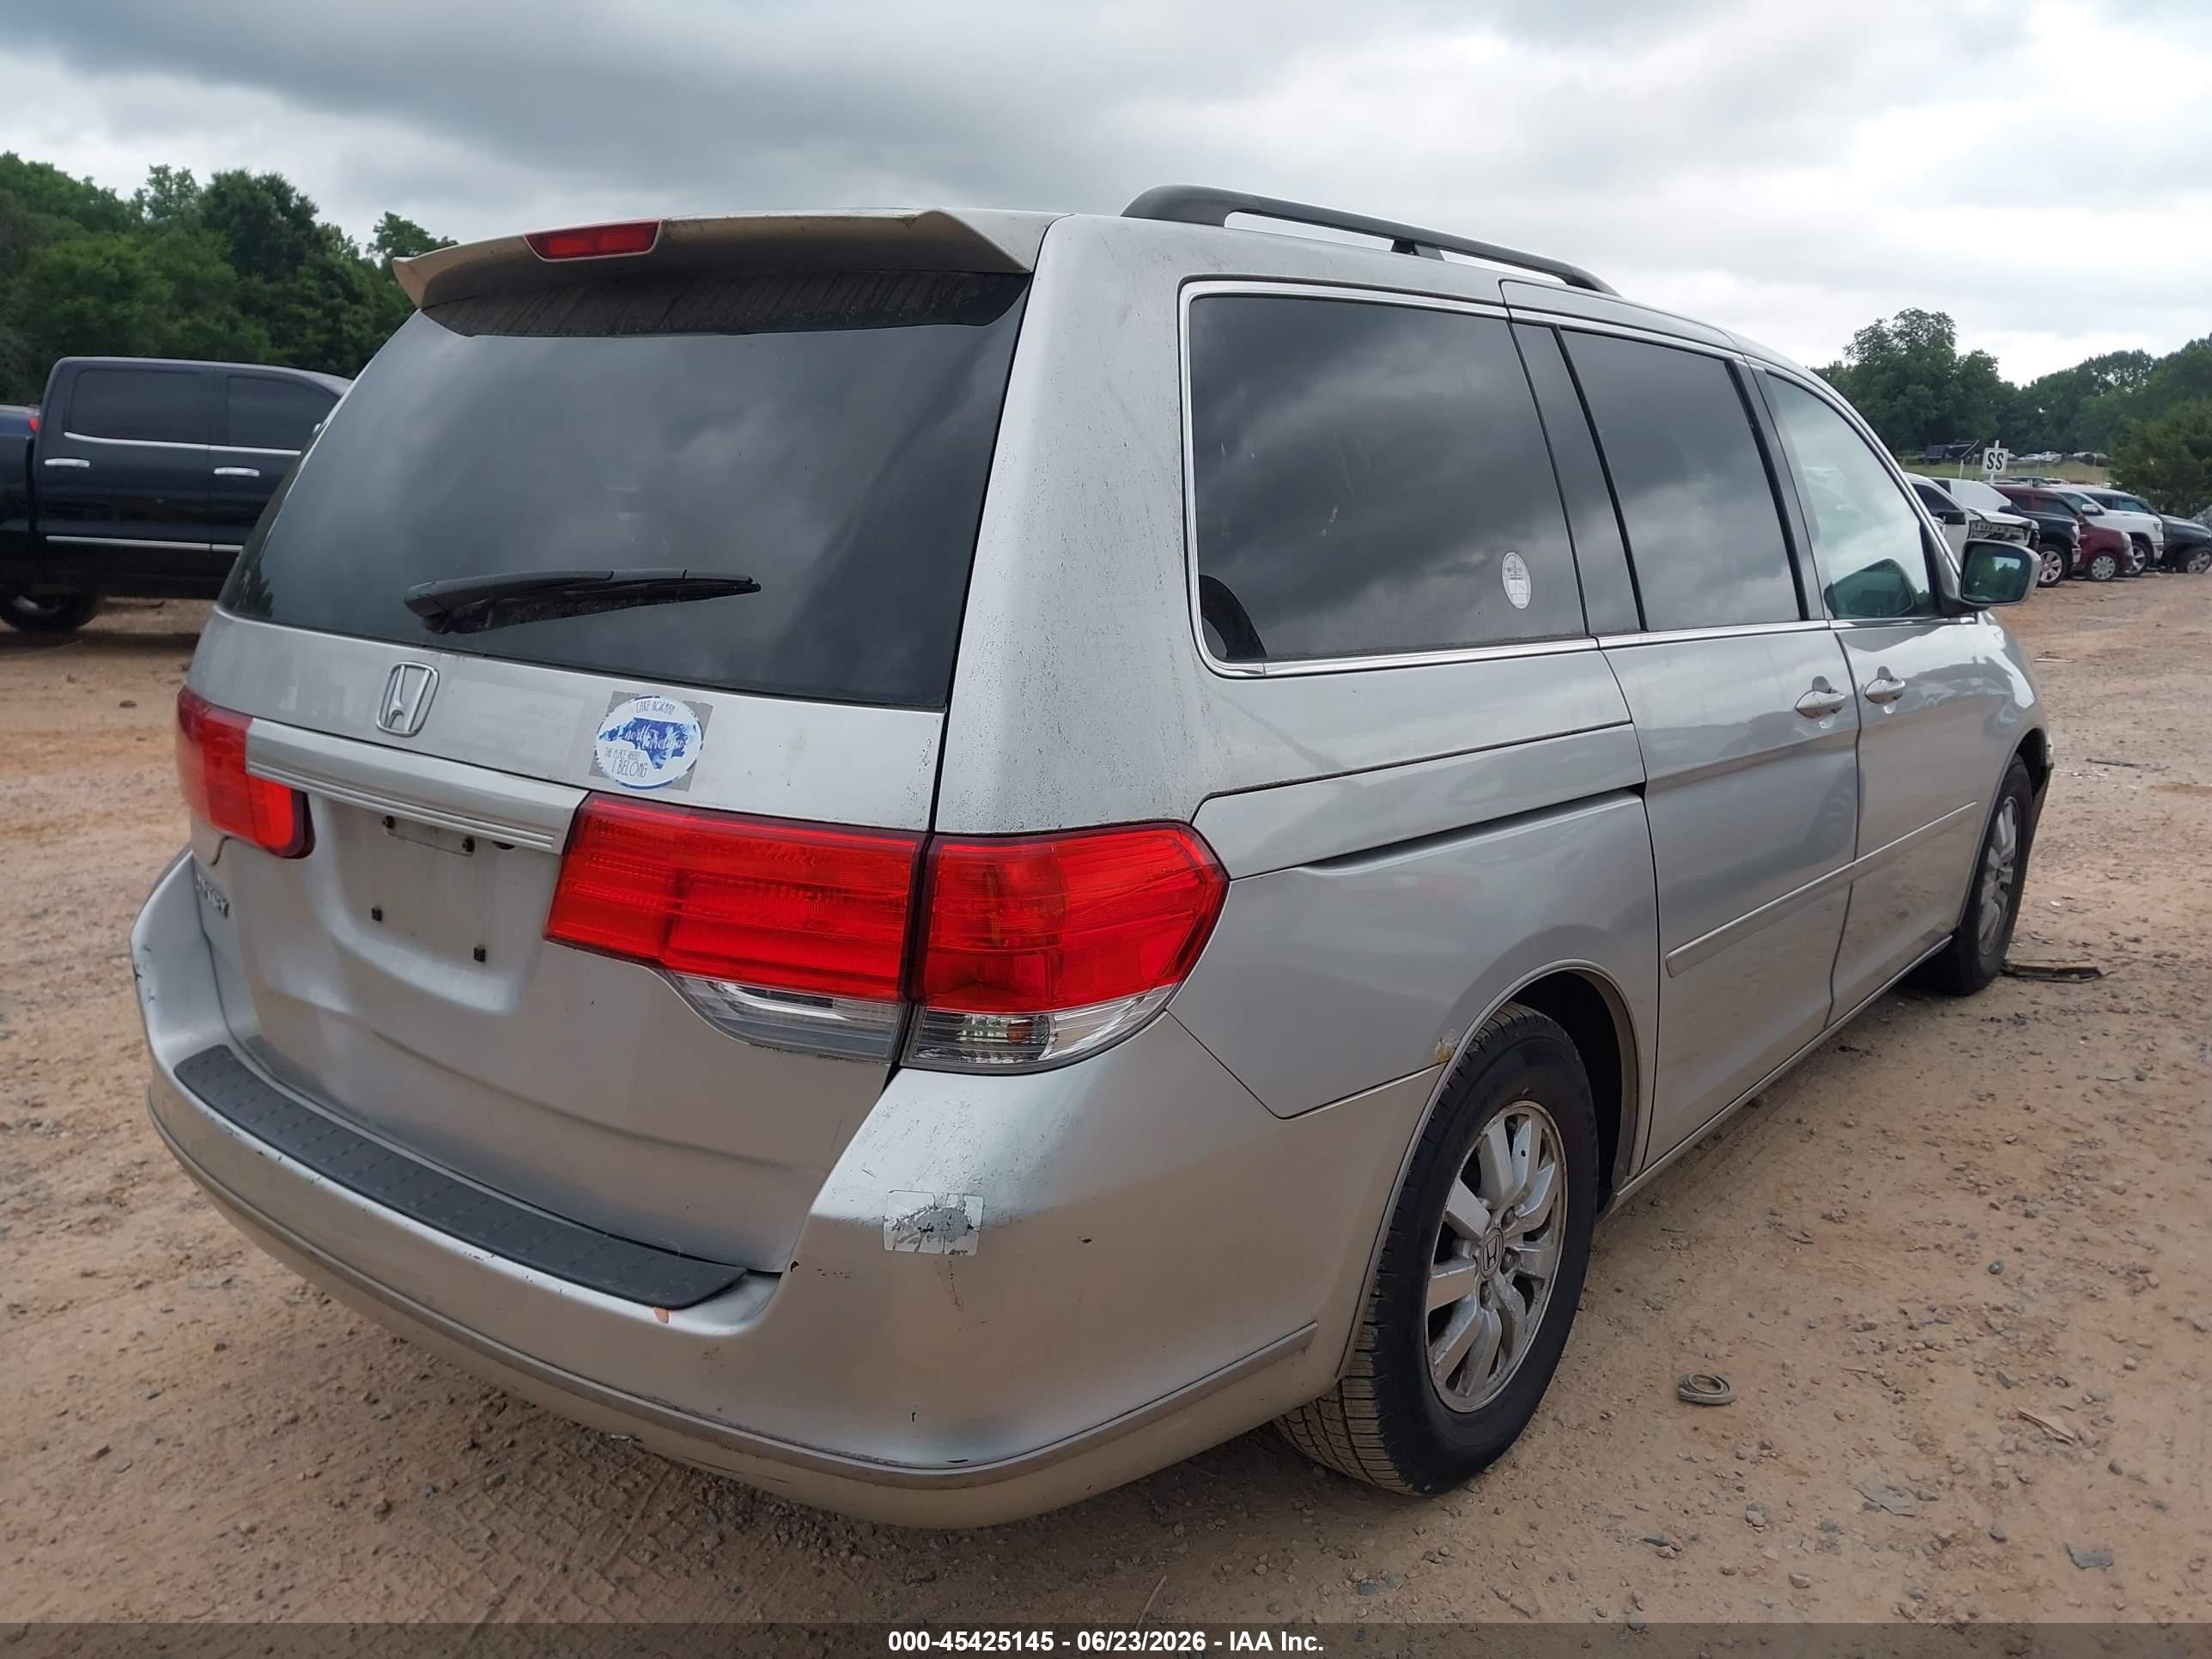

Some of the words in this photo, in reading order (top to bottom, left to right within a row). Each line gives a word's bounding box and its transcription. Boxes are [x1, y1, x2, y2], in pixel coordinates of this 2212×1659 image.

[1986, 452, 2004, 471] SS
[637, 701, 651, 714] LAKE
[653, 701, 675, 714] NORMAN
[617, 759, 648, 778] BELONG
